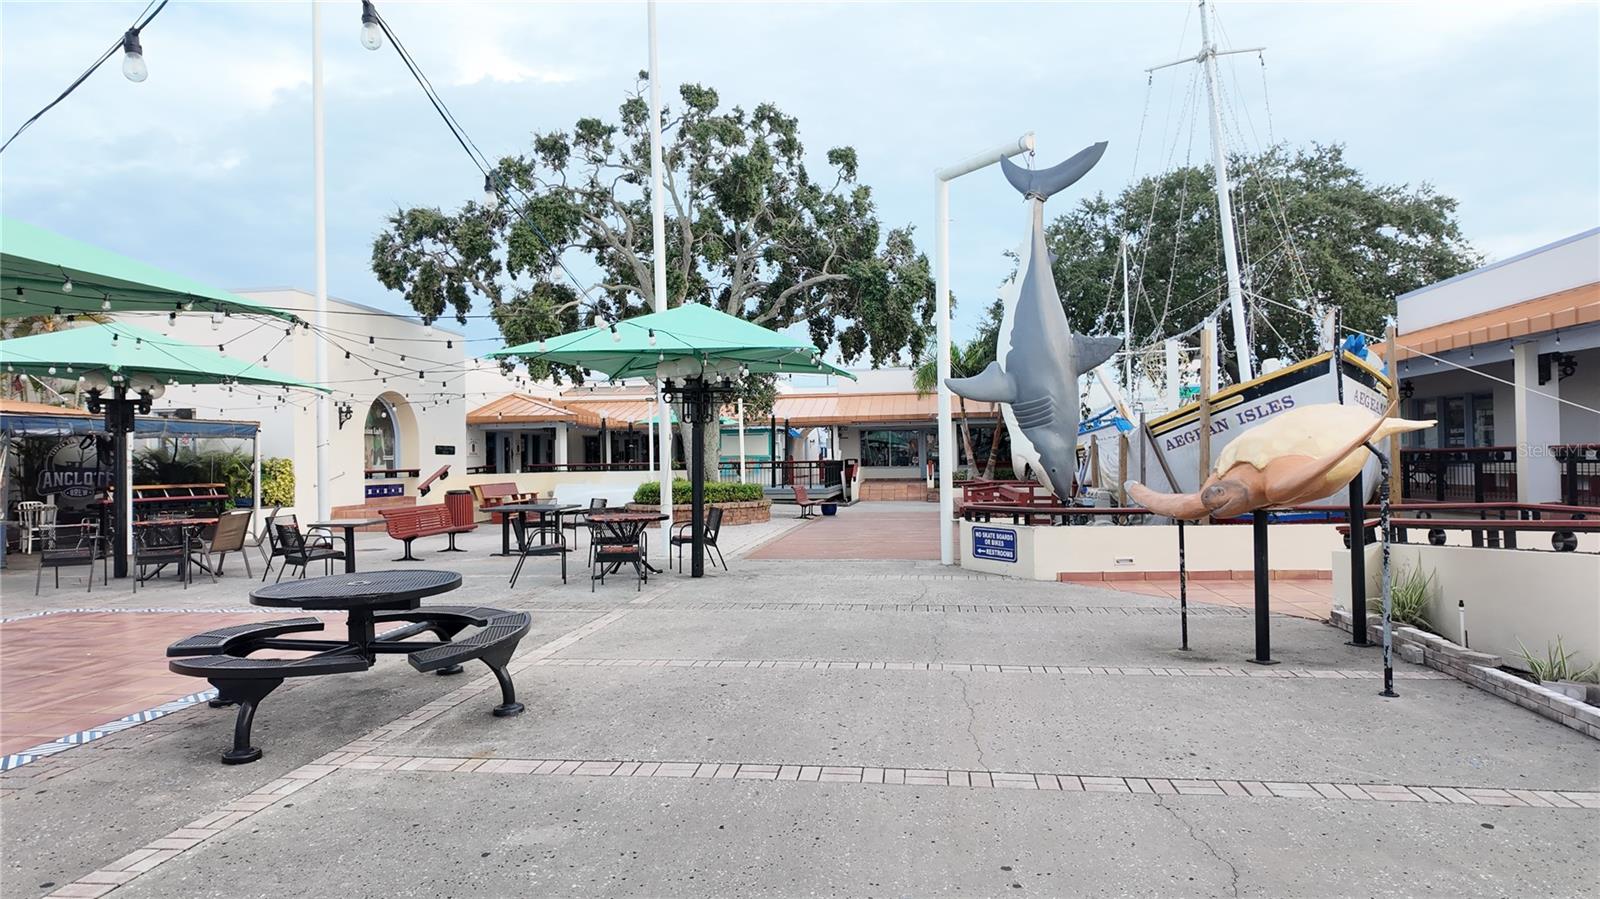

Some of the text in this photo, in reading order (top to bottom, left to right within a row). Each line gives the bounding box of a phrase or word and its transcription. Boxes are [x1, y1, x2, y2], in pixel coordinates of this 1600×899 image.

[1238, 395, 1296, 426] ISLES
[996, 533, 1013, 541] BOARDS
[986, 549, 1013, 557] RESTROOMS
